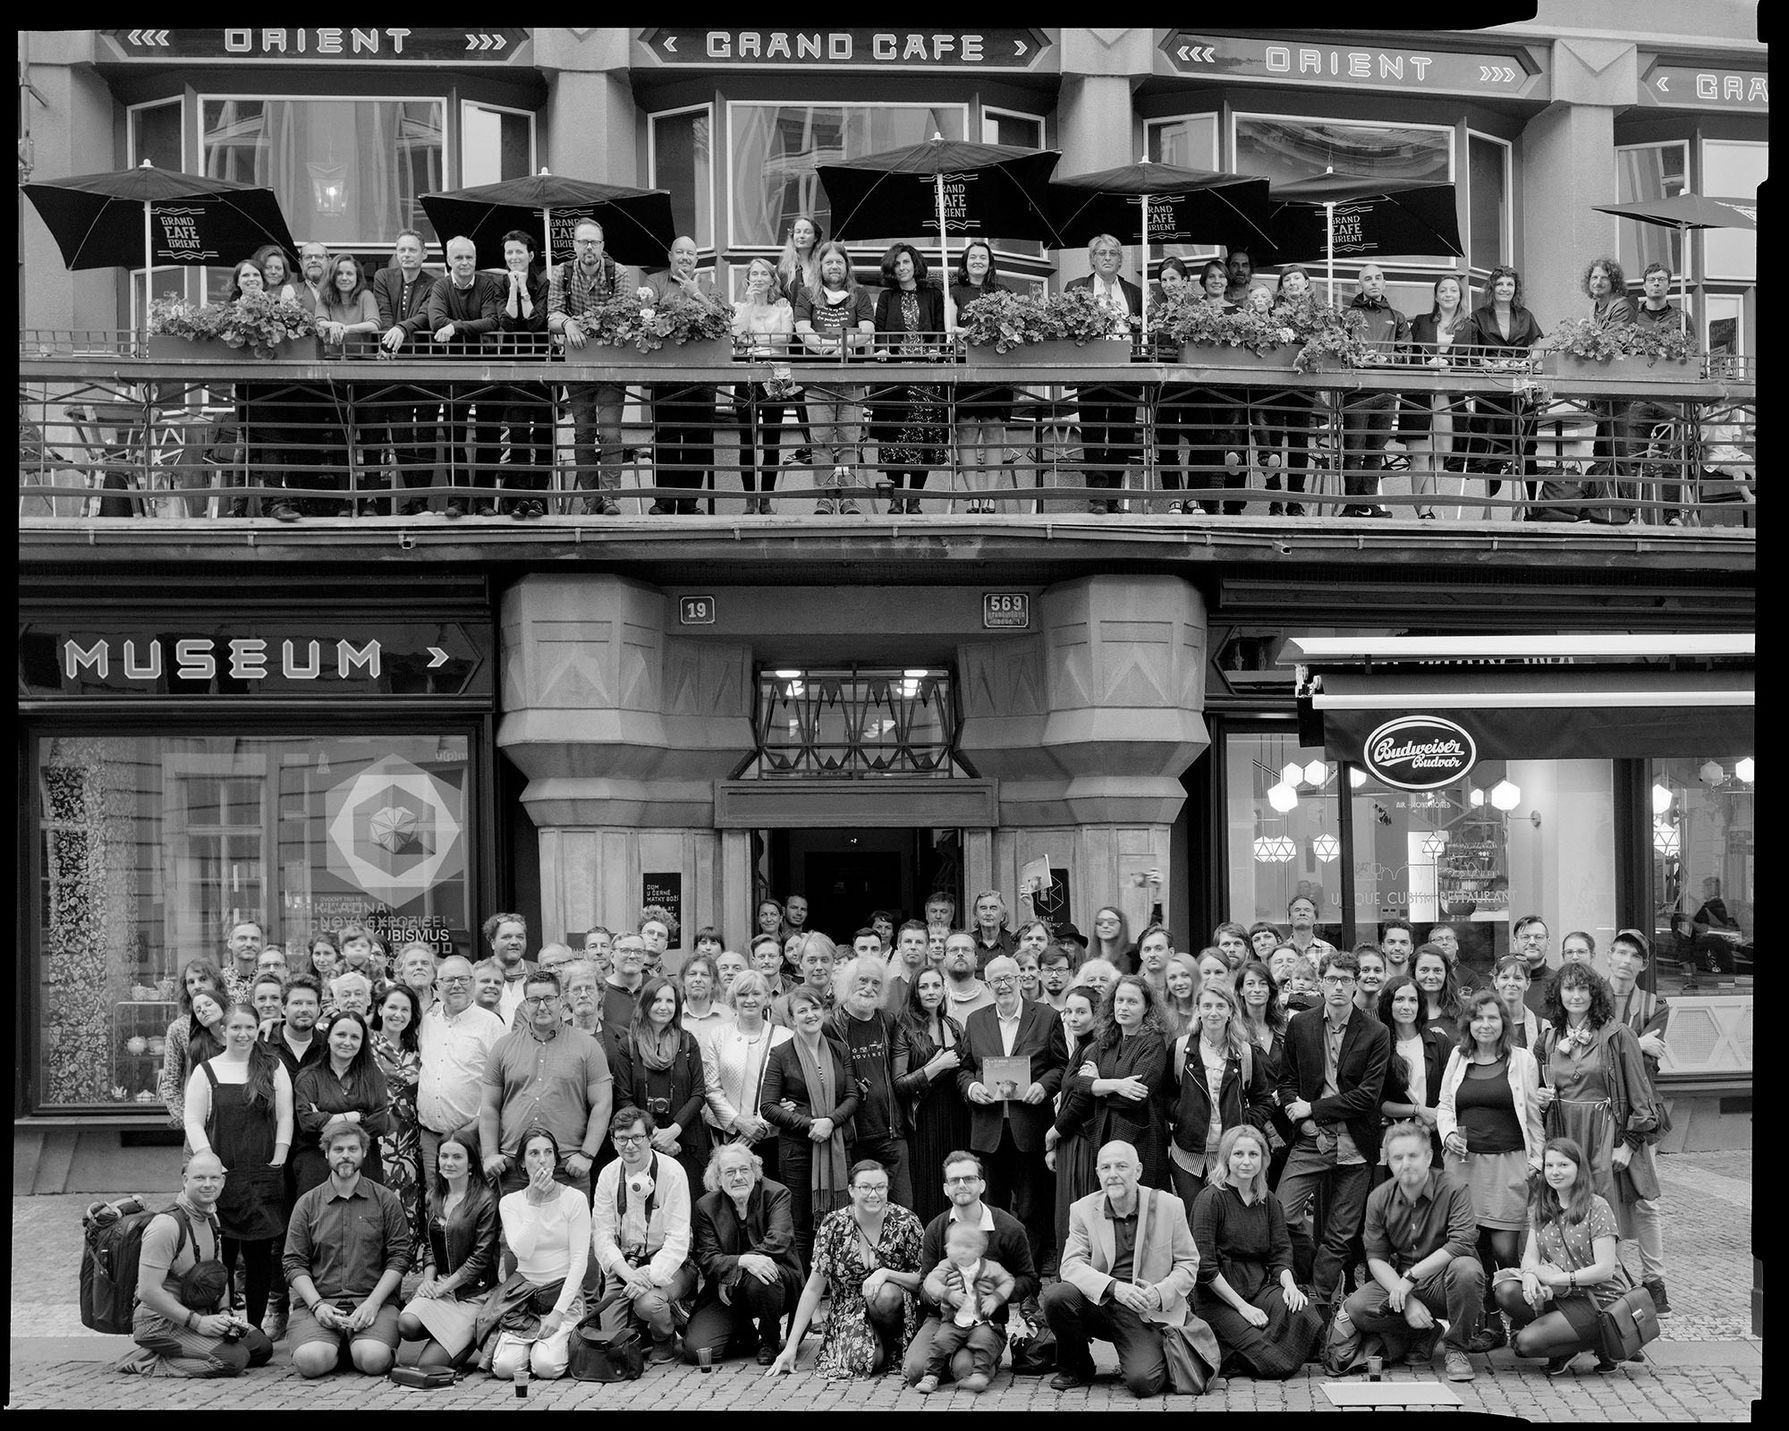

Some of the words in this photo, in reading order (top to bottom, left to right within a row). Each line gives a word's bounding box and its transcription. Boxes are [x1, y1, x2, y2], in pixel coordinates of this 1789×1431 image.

[225, 28, 411, 53] ORIENT
[706, 31, 853, 59] GRAND
[873, 33, 984, 61] CAFE
[1266, 46, 1433, 81] ORIENT
[160, 216, 195, 226] GRAND
[164, 226, 200, 239] CAFE
[168, 239, 201, 249] ORIENT
[687, 602, 707, 618] 19
[991, 596, 1022, 611] 569
[64, 639, 382, 680] MUSEUM
[1374, 737, 1465, 764] Budweiser
[1412, 753, 1463, 769] Budvar
